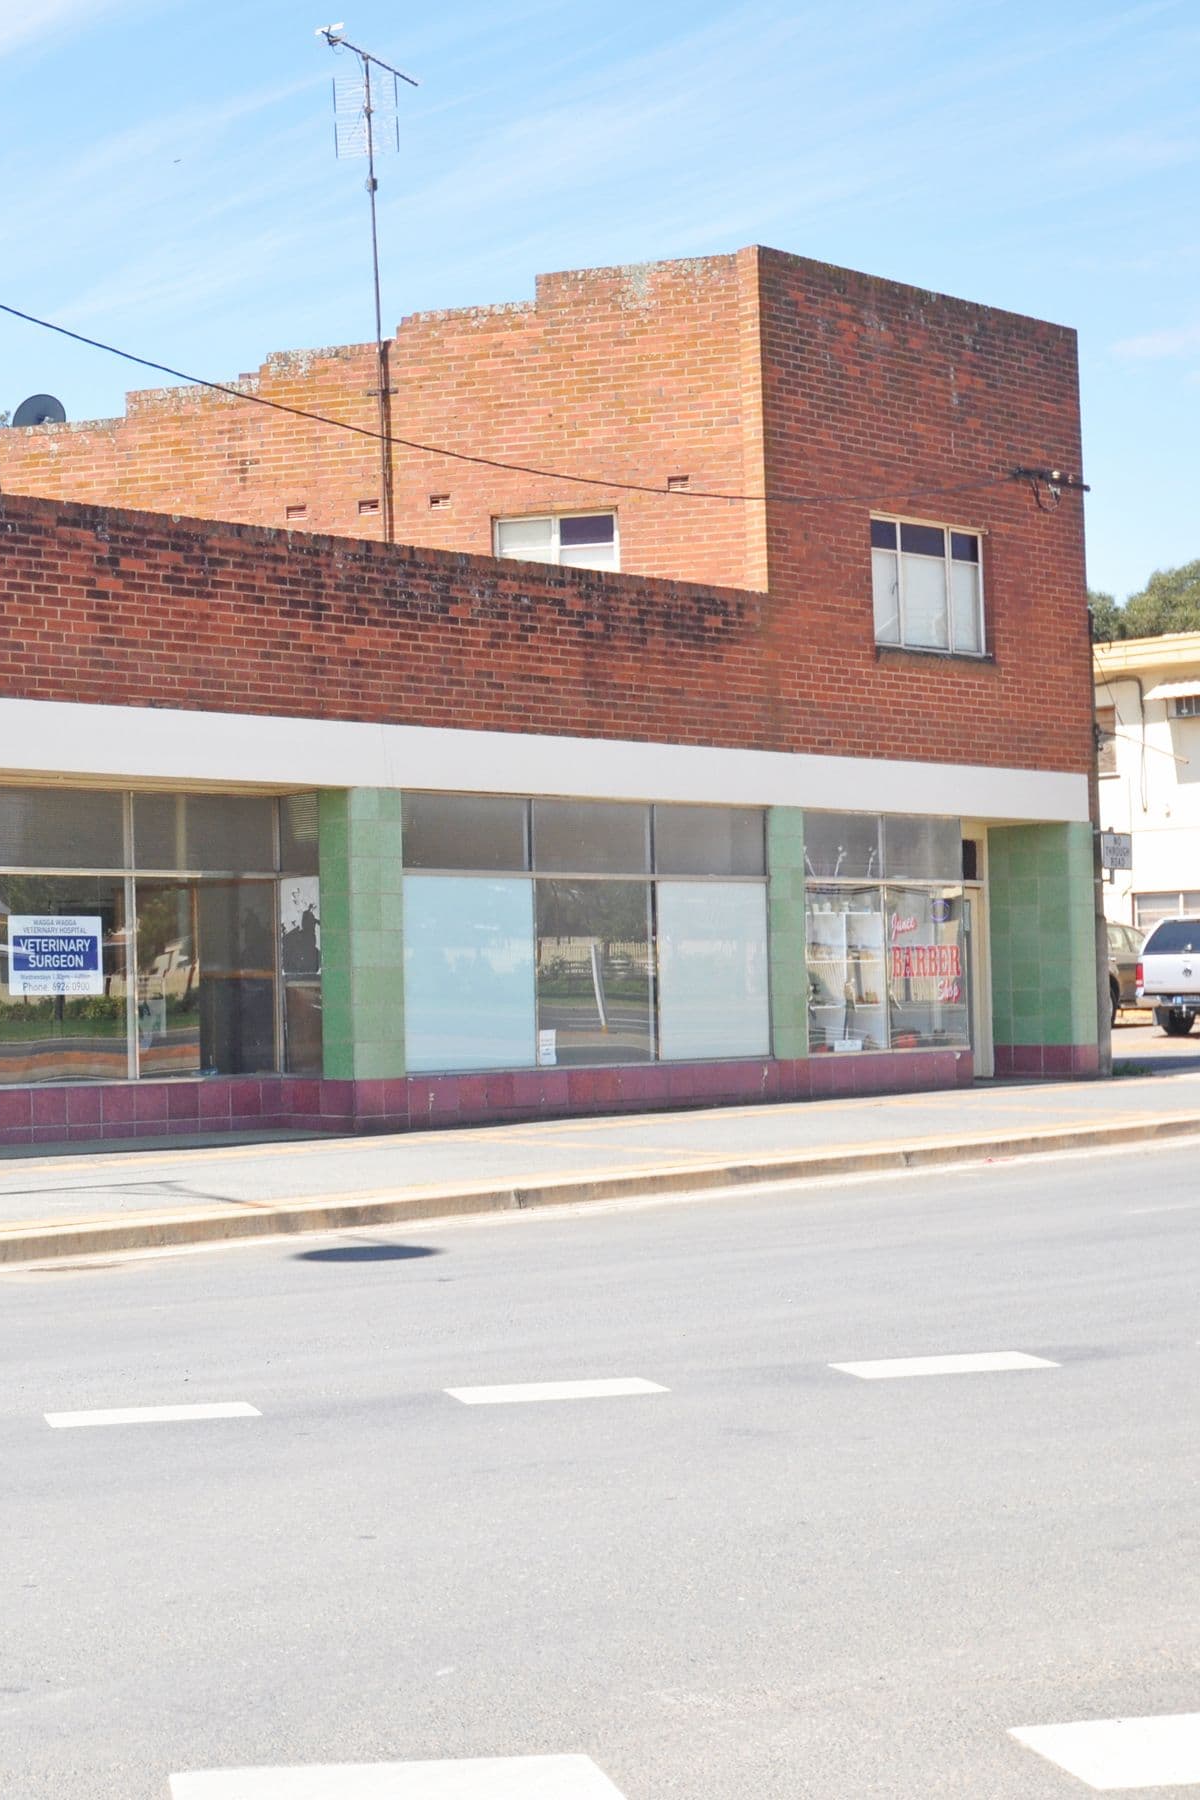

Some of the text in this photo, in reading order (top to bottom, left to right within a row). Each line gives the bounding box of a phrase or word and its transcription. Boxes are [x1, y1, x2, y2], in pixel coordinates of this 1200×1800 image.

[20, 939, 91, 952] VETERINARY
[28, 955, 84, 968] SURGEON
[891, 945, 961, 977] BARBER
